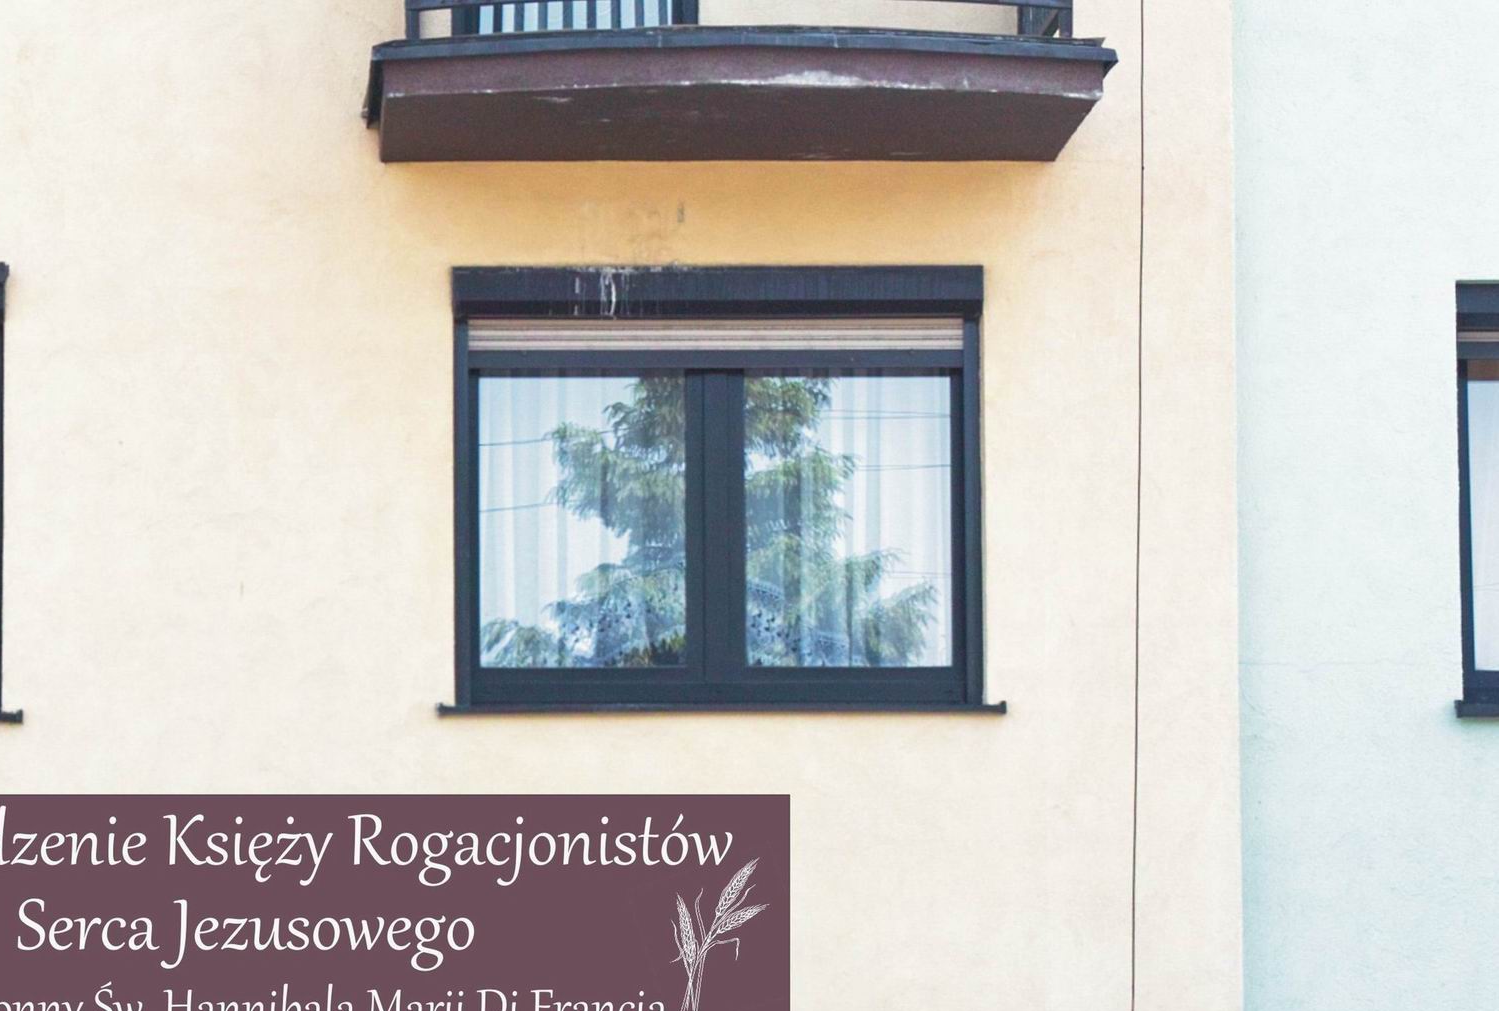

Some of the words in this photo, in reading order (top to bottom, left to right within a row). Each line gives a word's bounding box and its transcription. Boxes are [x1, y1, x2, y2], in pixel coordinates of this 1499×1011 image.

[163, 814, 333, 887] Księży
[348, 813, 733, 887] Rogacjonistów
[17, 898, 159, 951] Serca
[161, 899, 475, 972] Jezusowego
